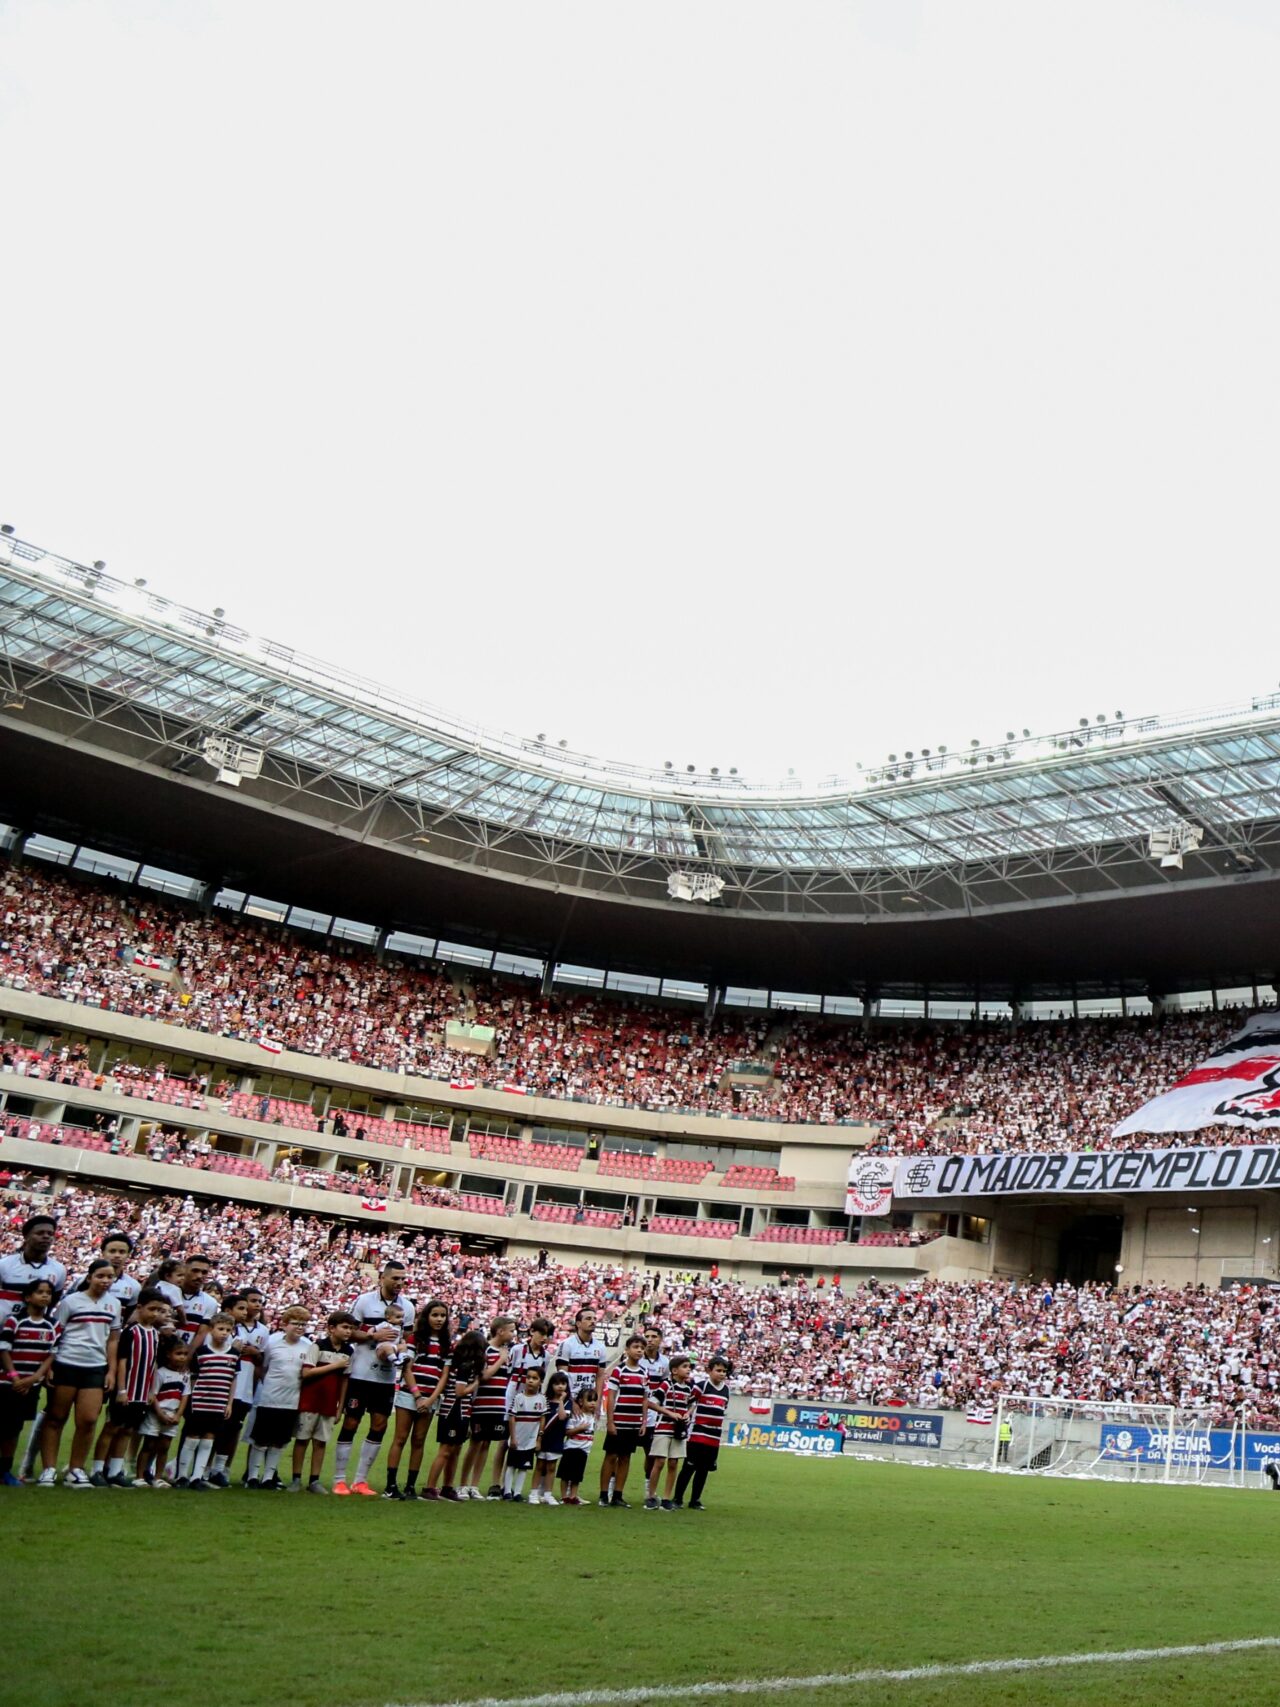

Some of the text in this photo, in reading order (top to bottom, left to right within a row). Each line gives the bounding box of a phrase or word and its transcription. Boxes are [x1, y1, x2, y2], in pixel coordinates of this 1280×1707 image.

[937, 1155, 964, 1193] O
[961, 1153, 1068, 1192] MAIOR
[1065, 1150, 1242, 1190] EXEMPLO
[800, 1410, 901, 1431] PENMBUCO
[748, 1427, 777, 1446] Bet
[777, 1431, 789, 1443] dá
[788, 1430, 835, 1452] Sorte
[1254, 1442, 1280, 1454] Você
